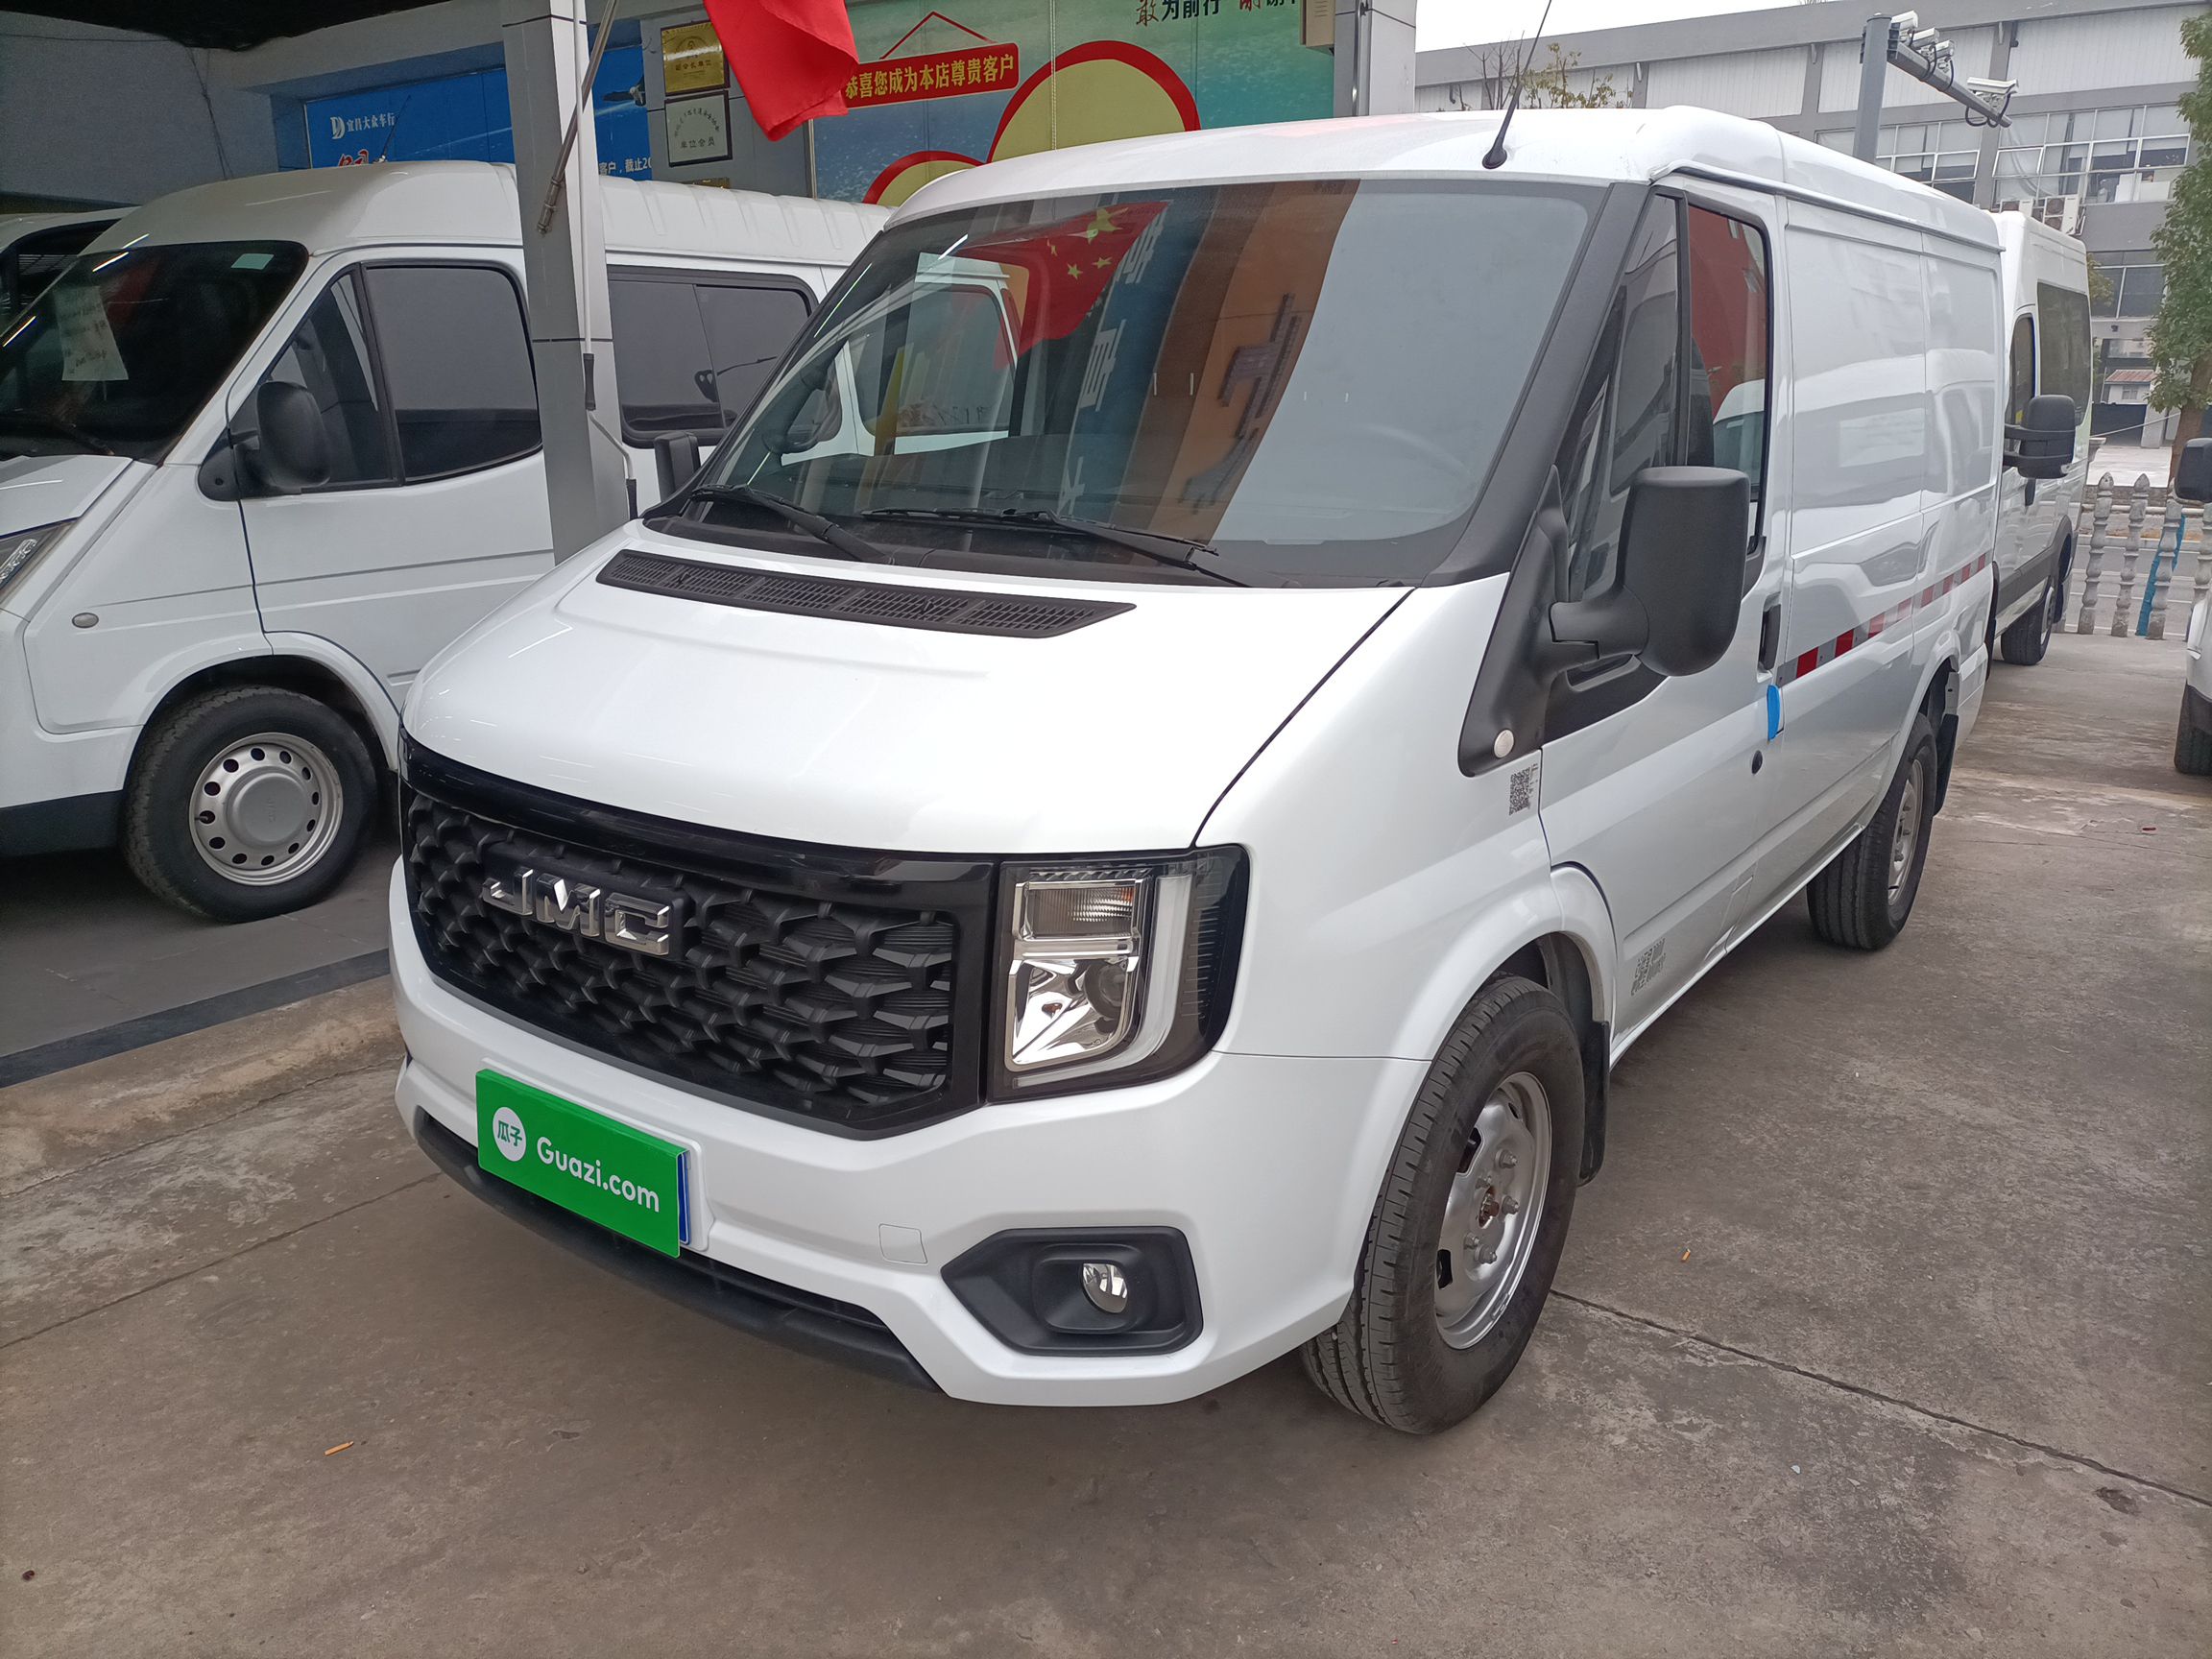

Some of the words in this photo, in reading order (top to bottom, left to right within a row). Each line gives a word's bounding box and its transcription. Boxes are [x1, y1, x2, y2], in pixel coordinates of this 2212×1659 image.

[482, 866, 669, 956] JMC
[496, 1119, 523, 1147] 瓜子
[537, 1136, 660, 1213] Guazi.com
